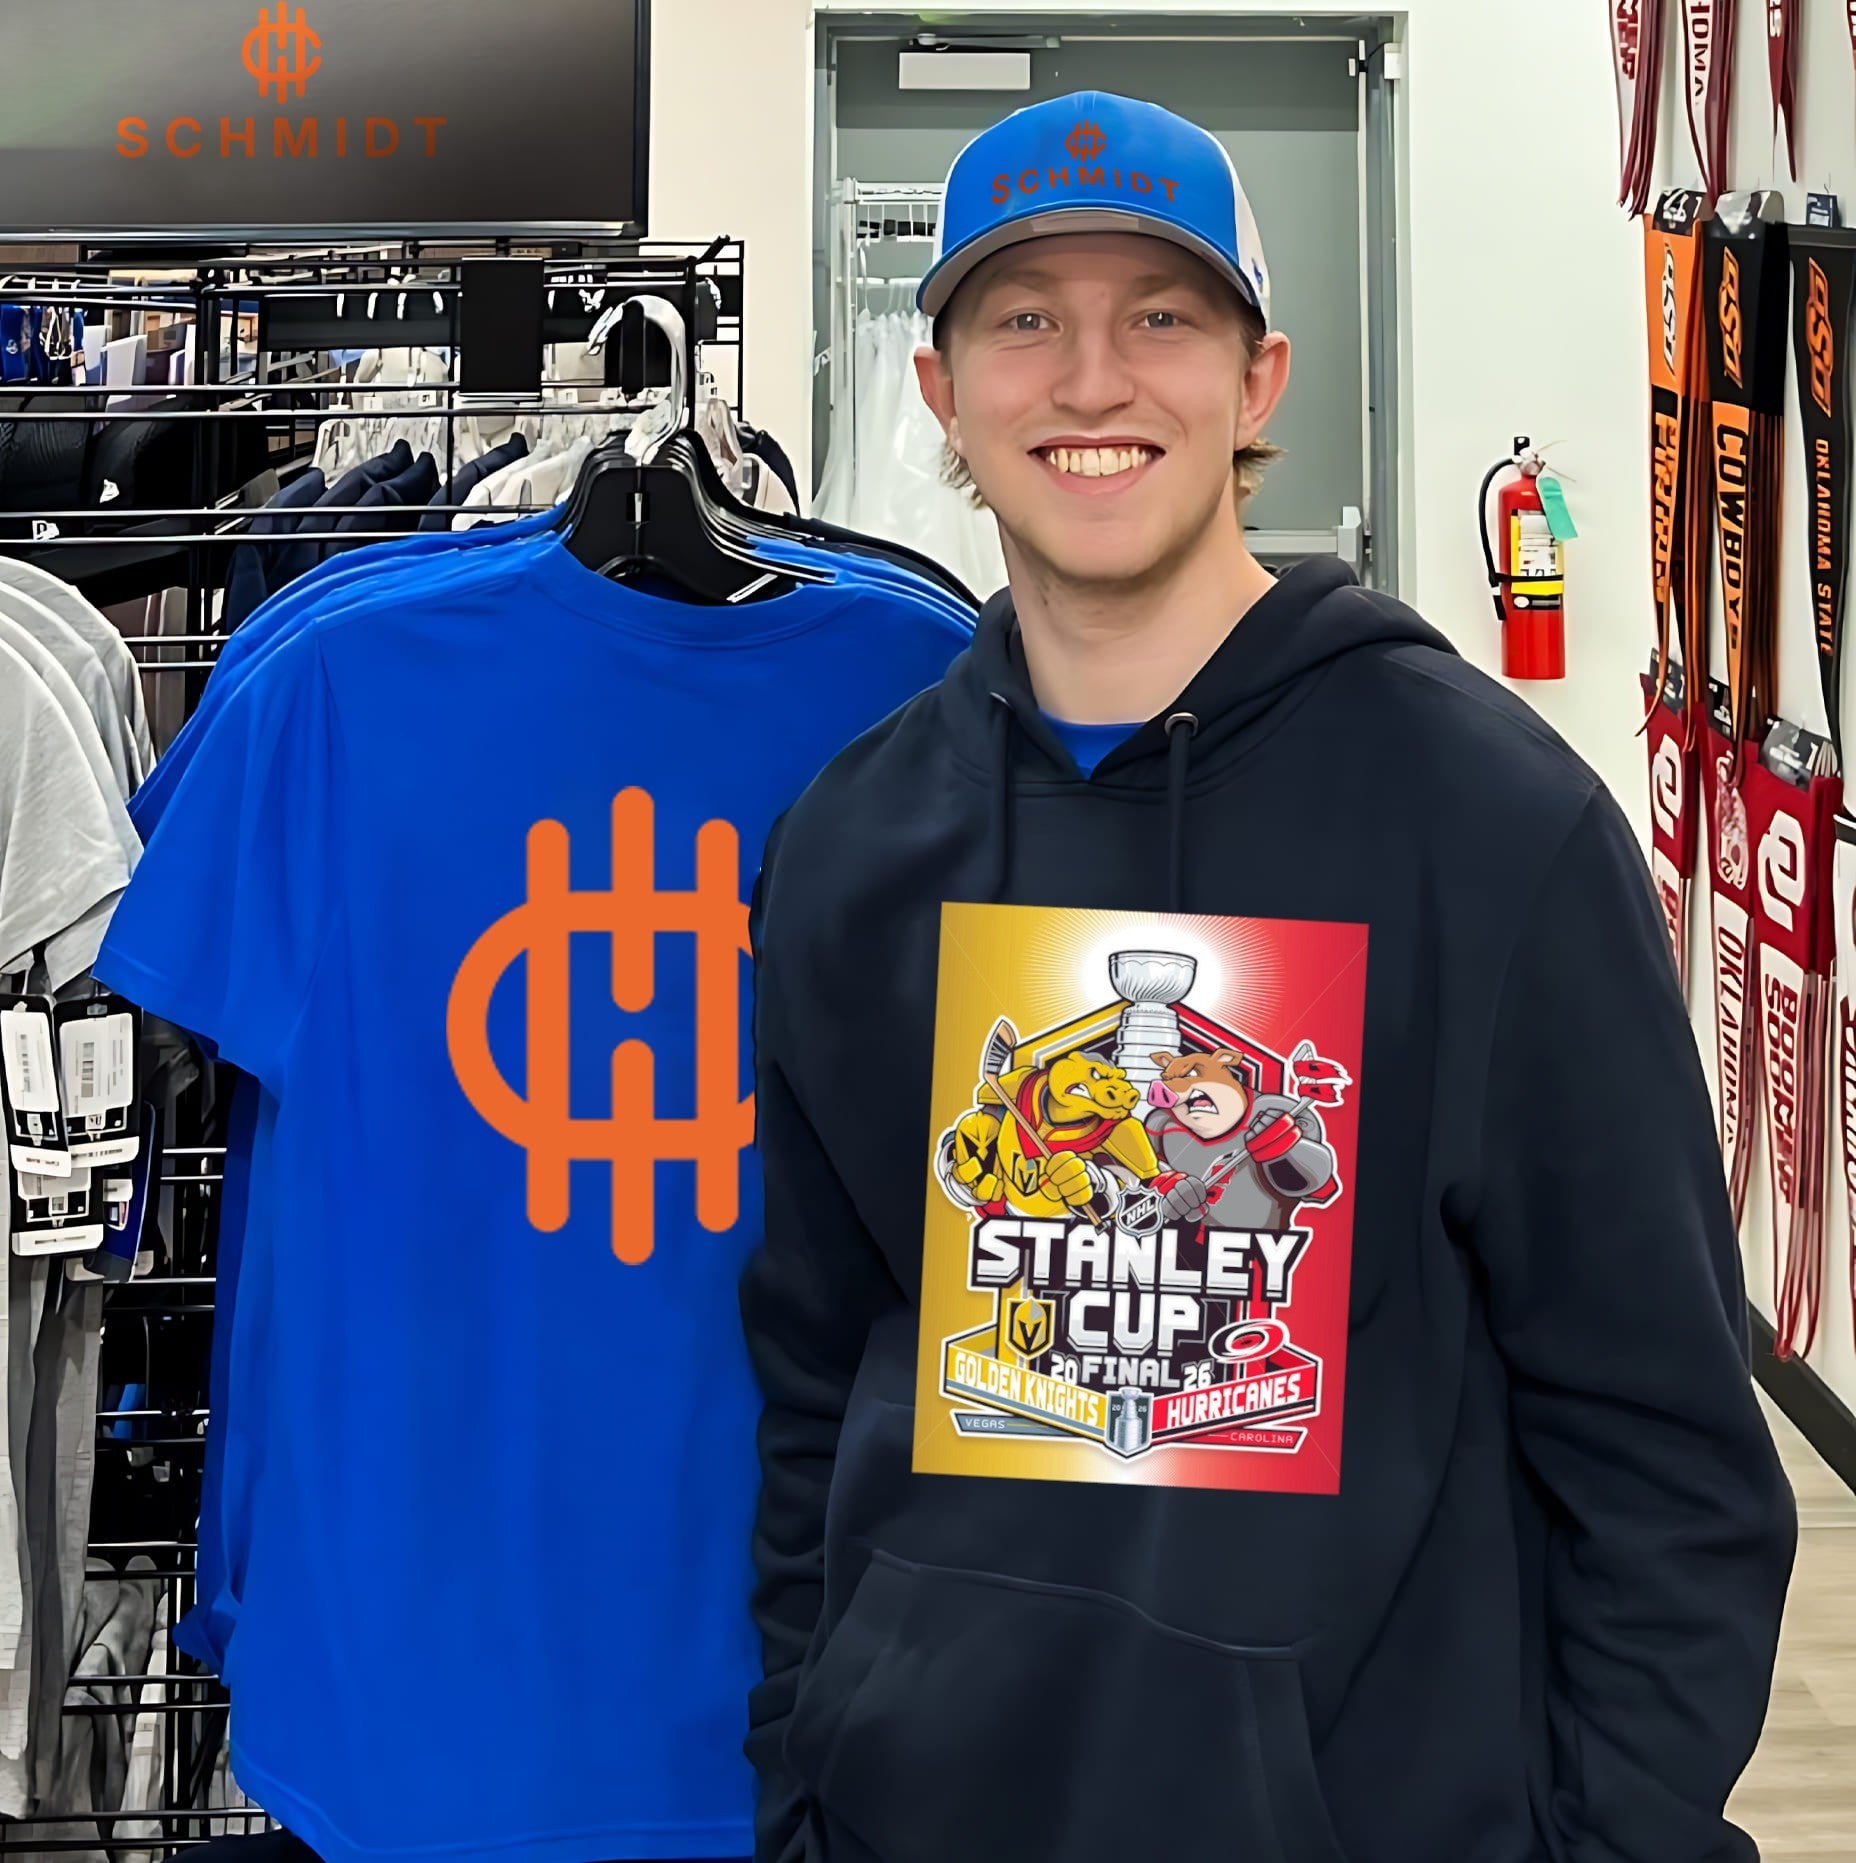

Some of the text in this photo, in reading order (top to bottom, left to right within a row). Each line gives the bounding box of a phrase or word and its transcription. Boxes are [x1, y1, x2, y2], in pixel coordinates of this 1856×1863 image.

[115, 116, 447, 159] SCHMIDT
[991, 166, 1180, 205] SCHMIDT
[1126, 1199, 1155, 1225] NHL
[976, 1218, 1300, 1298] STANLEY
[1066, 1289, 1201, 1357] CUP
[954, 1351, 1099, 1427] GOLDEN KNIGHTS
[1050, 1353, 1212, 1392] 20 FINAL 26
[1166, 1373, 1302, 1430] HURRICANES
[964, 1418, 1006, 1429] VEGAS
[1229, 1431, 1294, 1444] CAROLINA
